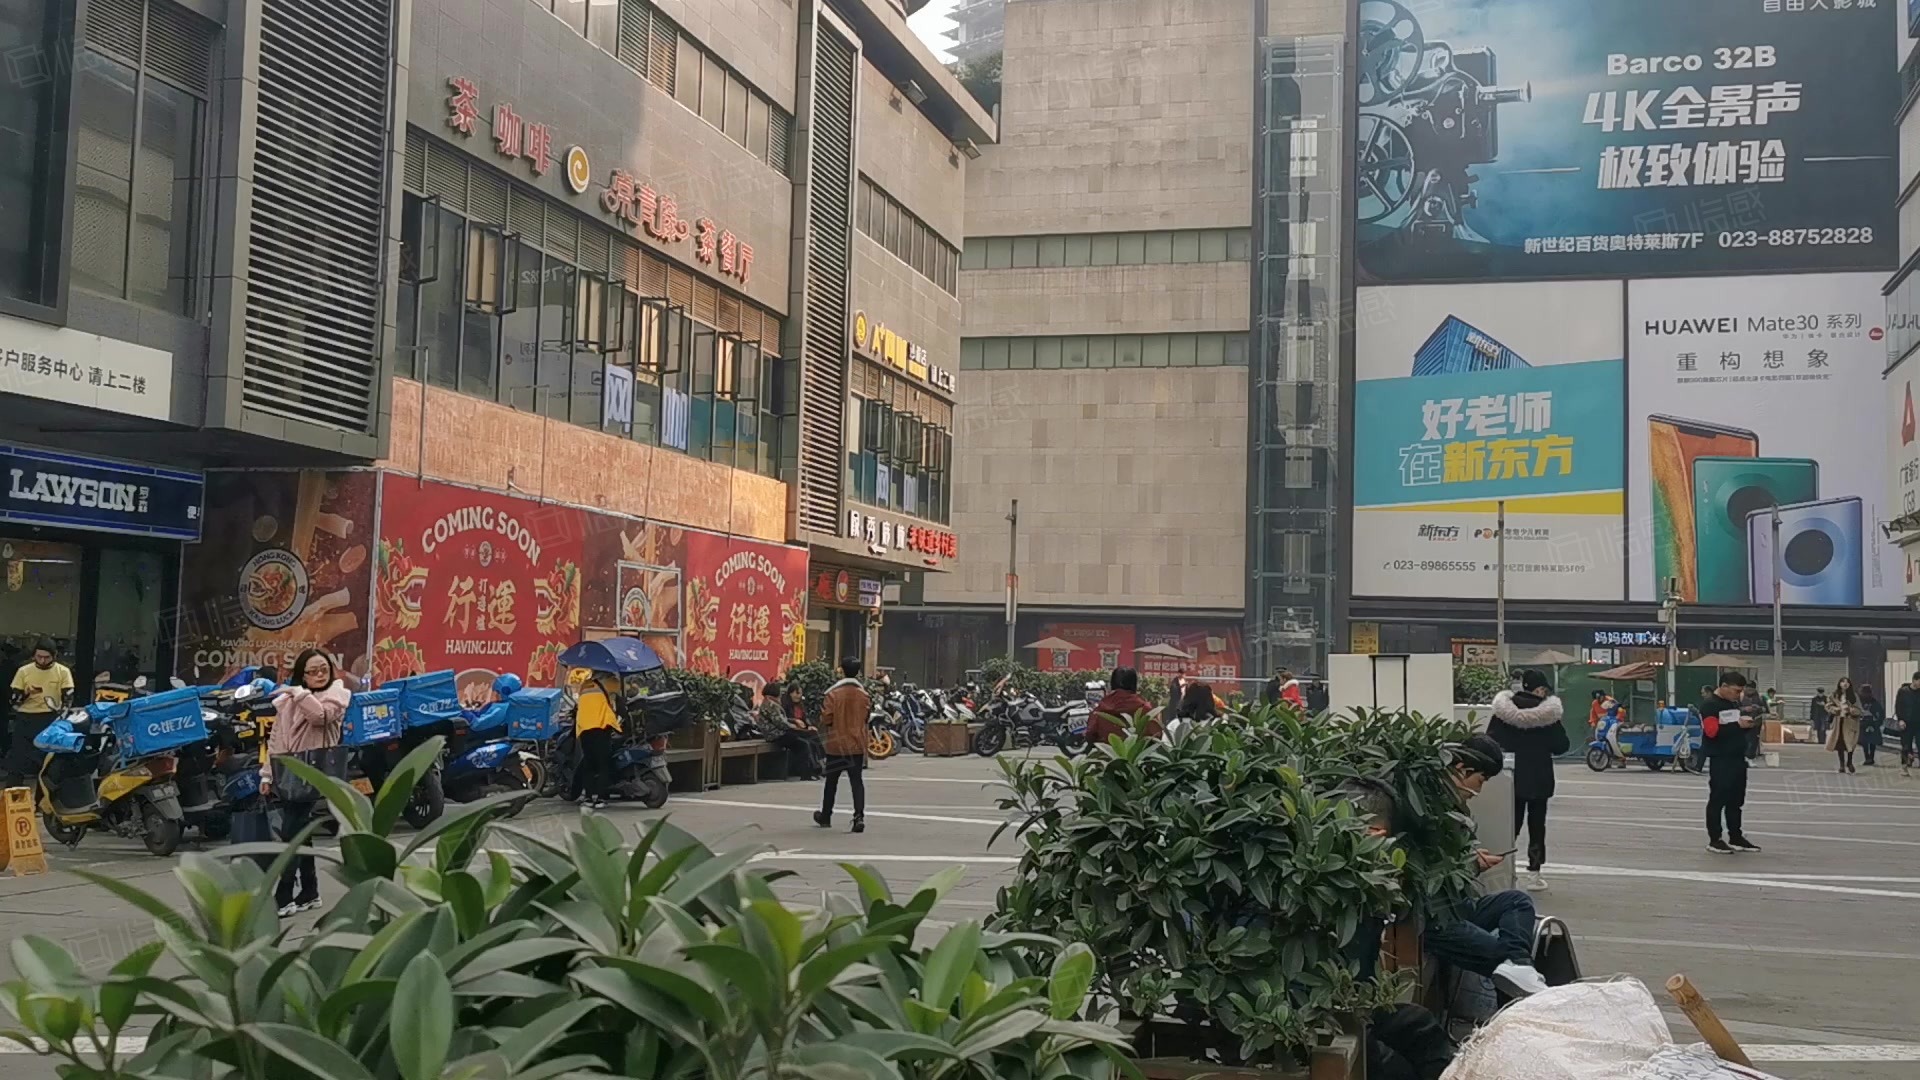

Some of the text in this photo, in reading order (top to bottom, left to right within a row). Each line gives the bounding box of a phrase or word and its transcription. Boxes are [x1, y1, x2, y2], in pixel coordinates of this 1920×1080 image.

[1607, 45, 1776, 76] Barco 32B
[1582, 81, 1802, 132] 4K全景声
[450, 76, 552, 175] 茶 咖啡
[1597, 139, 1786, 189] 极致体验
[698, 217, 754, 285] 茶餐厅
[1524, 226, 1873, 254] 新世纪百货奥特莱斯7F 023-88752828
[1645, 313, 1862, 336] HUAWEI Mate30 系列
[0, 348, 146, 395] 户服务中心 请上二楼
[1422, 391, 1552, 441] 好老师
[1399, 434, 1573, 487] 在新东方
[9, 468, 136, 512] LAWSON
[422, 506, 495, 553] COMING
[496, 512, 541, 566] SOON
[1418, 524, 1460, 541] 新东方
[715, 551, 756, 587] COMING
[757, 554, 786, 595] SOON
[1393, 560, 1476, 571] 023-89865555
[1492, 565, 1585, 573] 新纪百货奥特莱斯5F09
[276, 611, 295, 624] LUCK
[194, 650, 344, 669] COMING SN
[446, 640, 513, 655] HAVING LUCK
[1709, 634, 1750, 650] ifree
